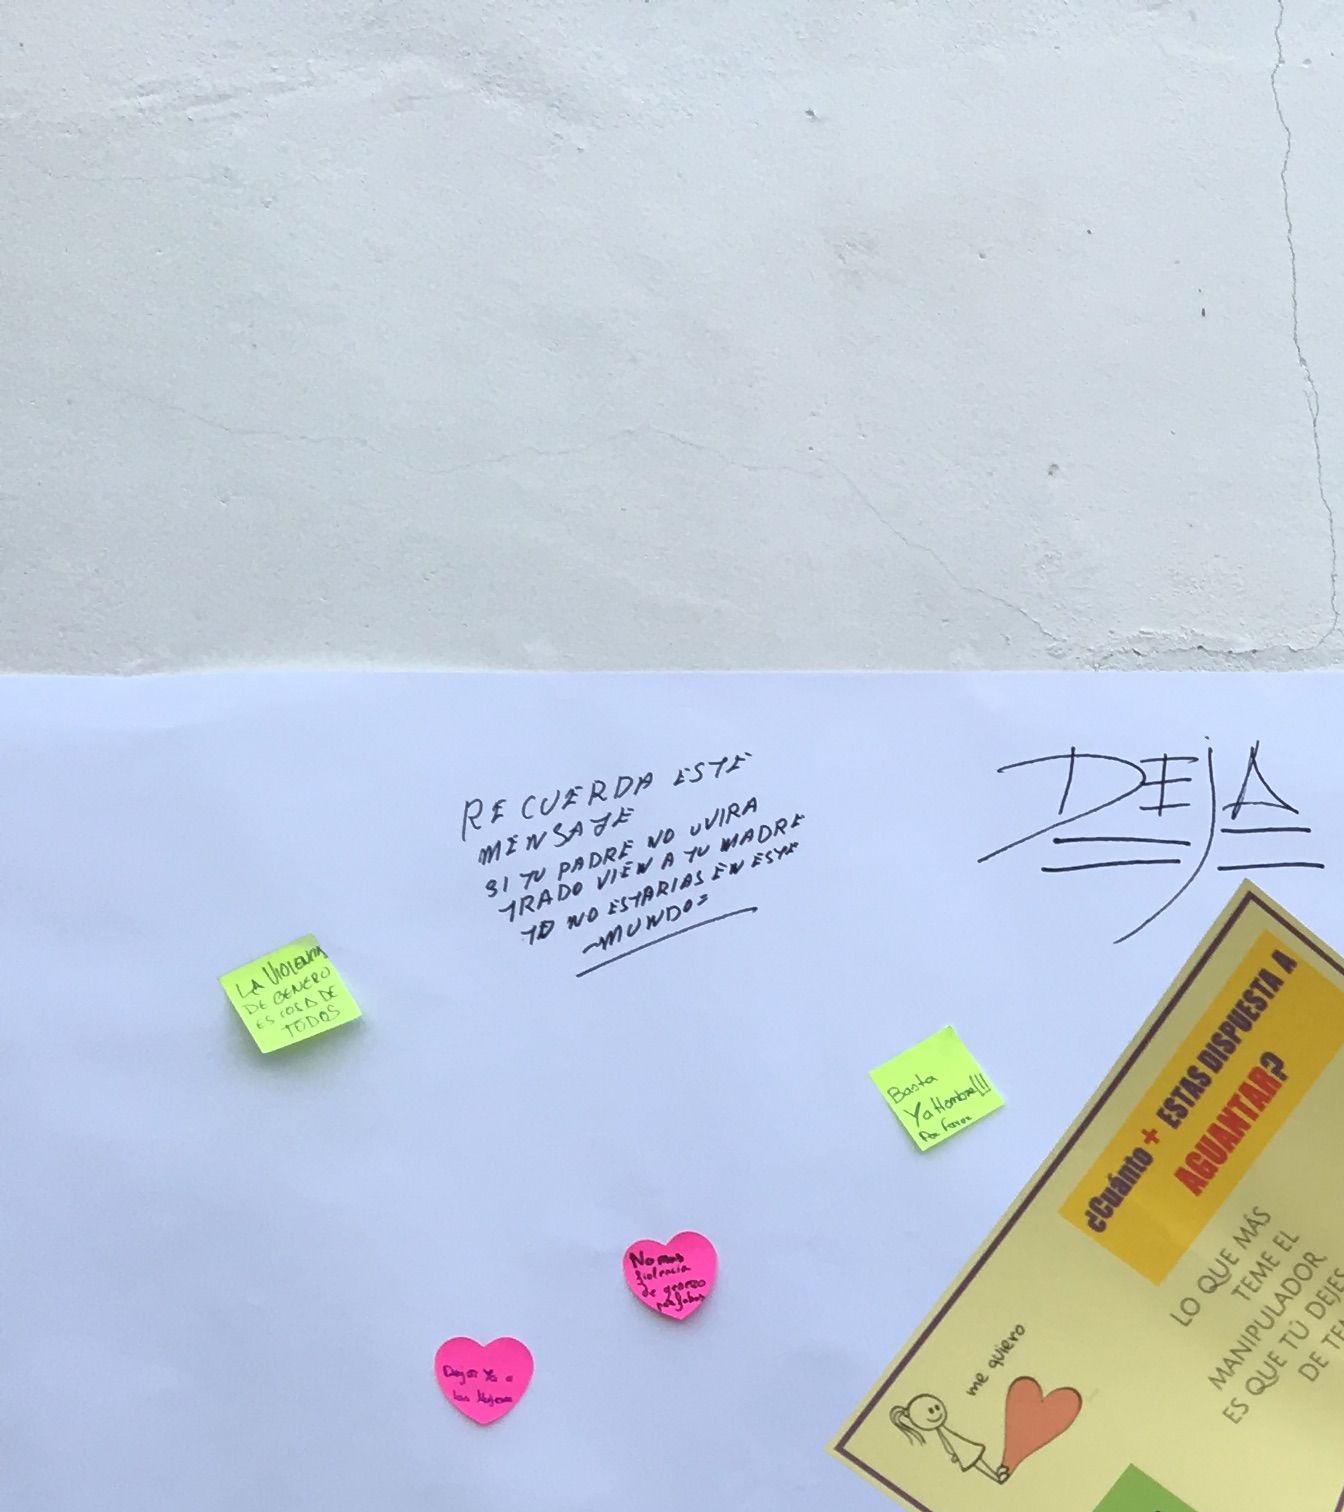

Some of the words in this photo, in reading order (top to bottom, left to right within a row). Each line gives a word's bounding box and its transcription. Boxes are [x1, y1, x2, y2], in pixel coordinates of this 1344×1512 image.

[674, 752, 752, 786] ESTE
[559, 841, 634, 880] PADRE
[648, 829, 675, 848] NO
[661, 852, 675, 870] A
[721, 814, 805, 852] MADRE
[568, 907, 598, 929] NO
[609, 870, 704, 915] ESTARIAS
[712, 860, 744, 882] EN
[236, 979, 264, 998] LA
[243, 1000, 267, 1015] DE
[256, 1016, 275, 1029] ES
[318, 986, 338, 1001] DE
[281, 1004, 340, 1037] TODOS
[887, 1074, 938, 1104] Basta
[1085, 1147, 1153, 1233] ¿Cuánto
[1156, 1065, 1212, 1130] ESTAS
[1196, 968, 1284, 1074] DISPUESTA
[1271, 950, 1297, 974] A
[1174, 1051, 1288, 1197] AGUANTAR?
[629, 1251, 655, 1268] No
[1170, 1297, 1200, 1327] LO
[1198, 1248, 1239, 1294] QUE
[1232, 1206, 1271, 1250] MÁS
[1231, 1251, 1280, 1301] TEME
[1272, 1231, 1300, 1252] EL
[1208, 1251, 1328, 1391] MANIPULADOR
[966, 1373, 989, 1396] me
[988, 1324, 1025, 1368] quiero
[1298, 1351, 1329, 1382] DE
[1222, 1397, 1250, 1424] ES
[1245, 1351, 1288, 1395] QUE
